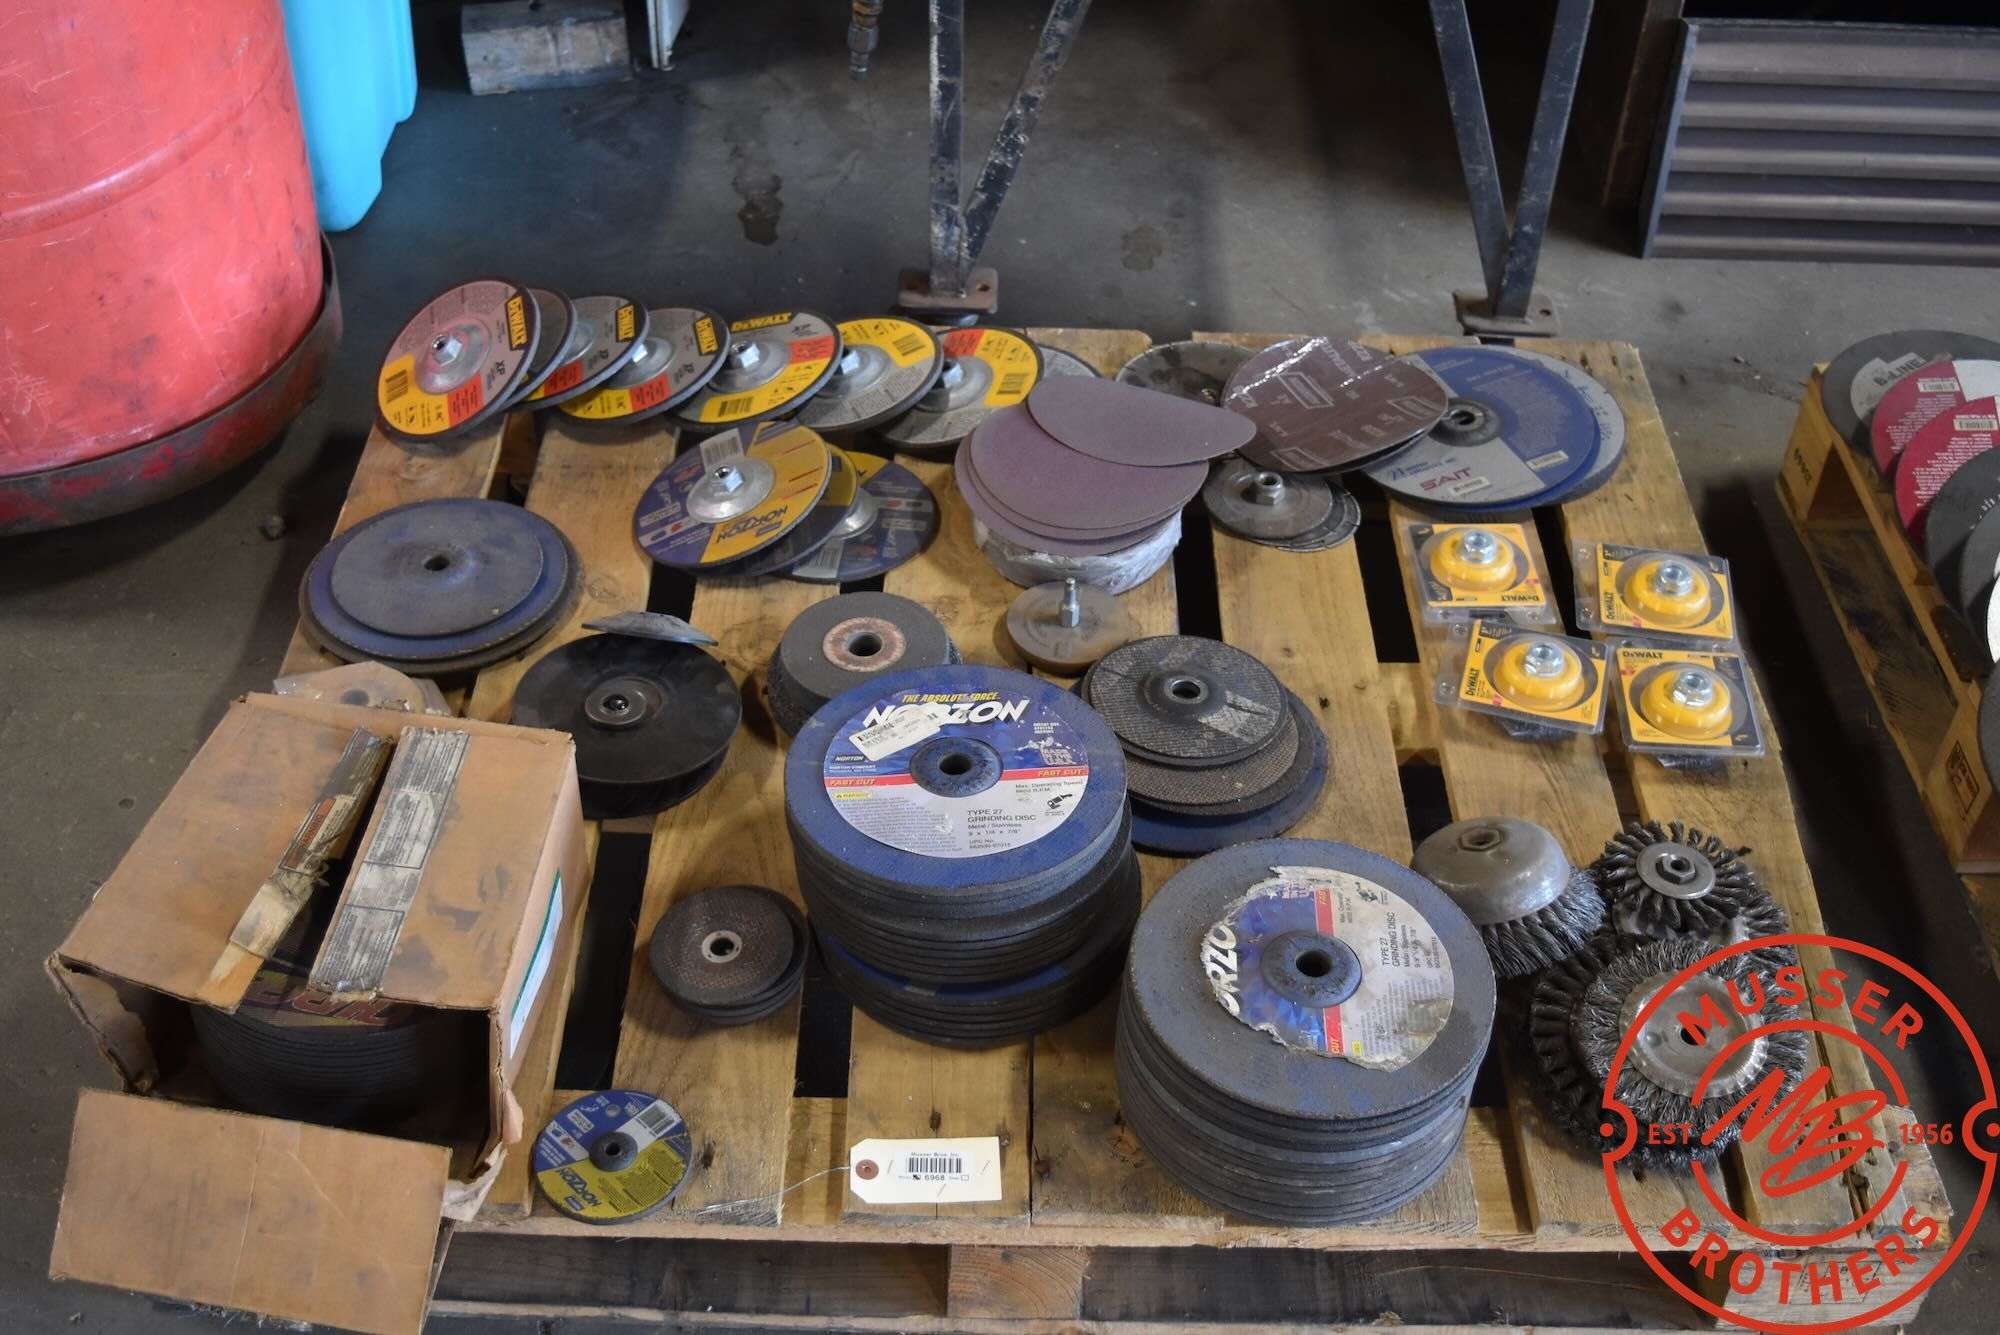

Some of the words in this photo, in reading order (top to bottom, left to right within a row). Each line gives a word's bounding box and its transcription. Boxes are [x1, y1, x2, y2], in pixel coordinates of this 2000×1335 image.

[1419, 466, 1471, 491] SAIT
[902, 694, 920, 703] THE
[970, 691, 1000, 702] FORCE
[857, 778, 876, 786] CUT
[967, 815, 1013, 823] GRINDING
[1014, 814, 1037, 822] DISC
[1386, 911, 1397, 930] DISC
[1381, 947, 1391, 967] TYPE
[1388, 930, 1401, 967] GRINDING
